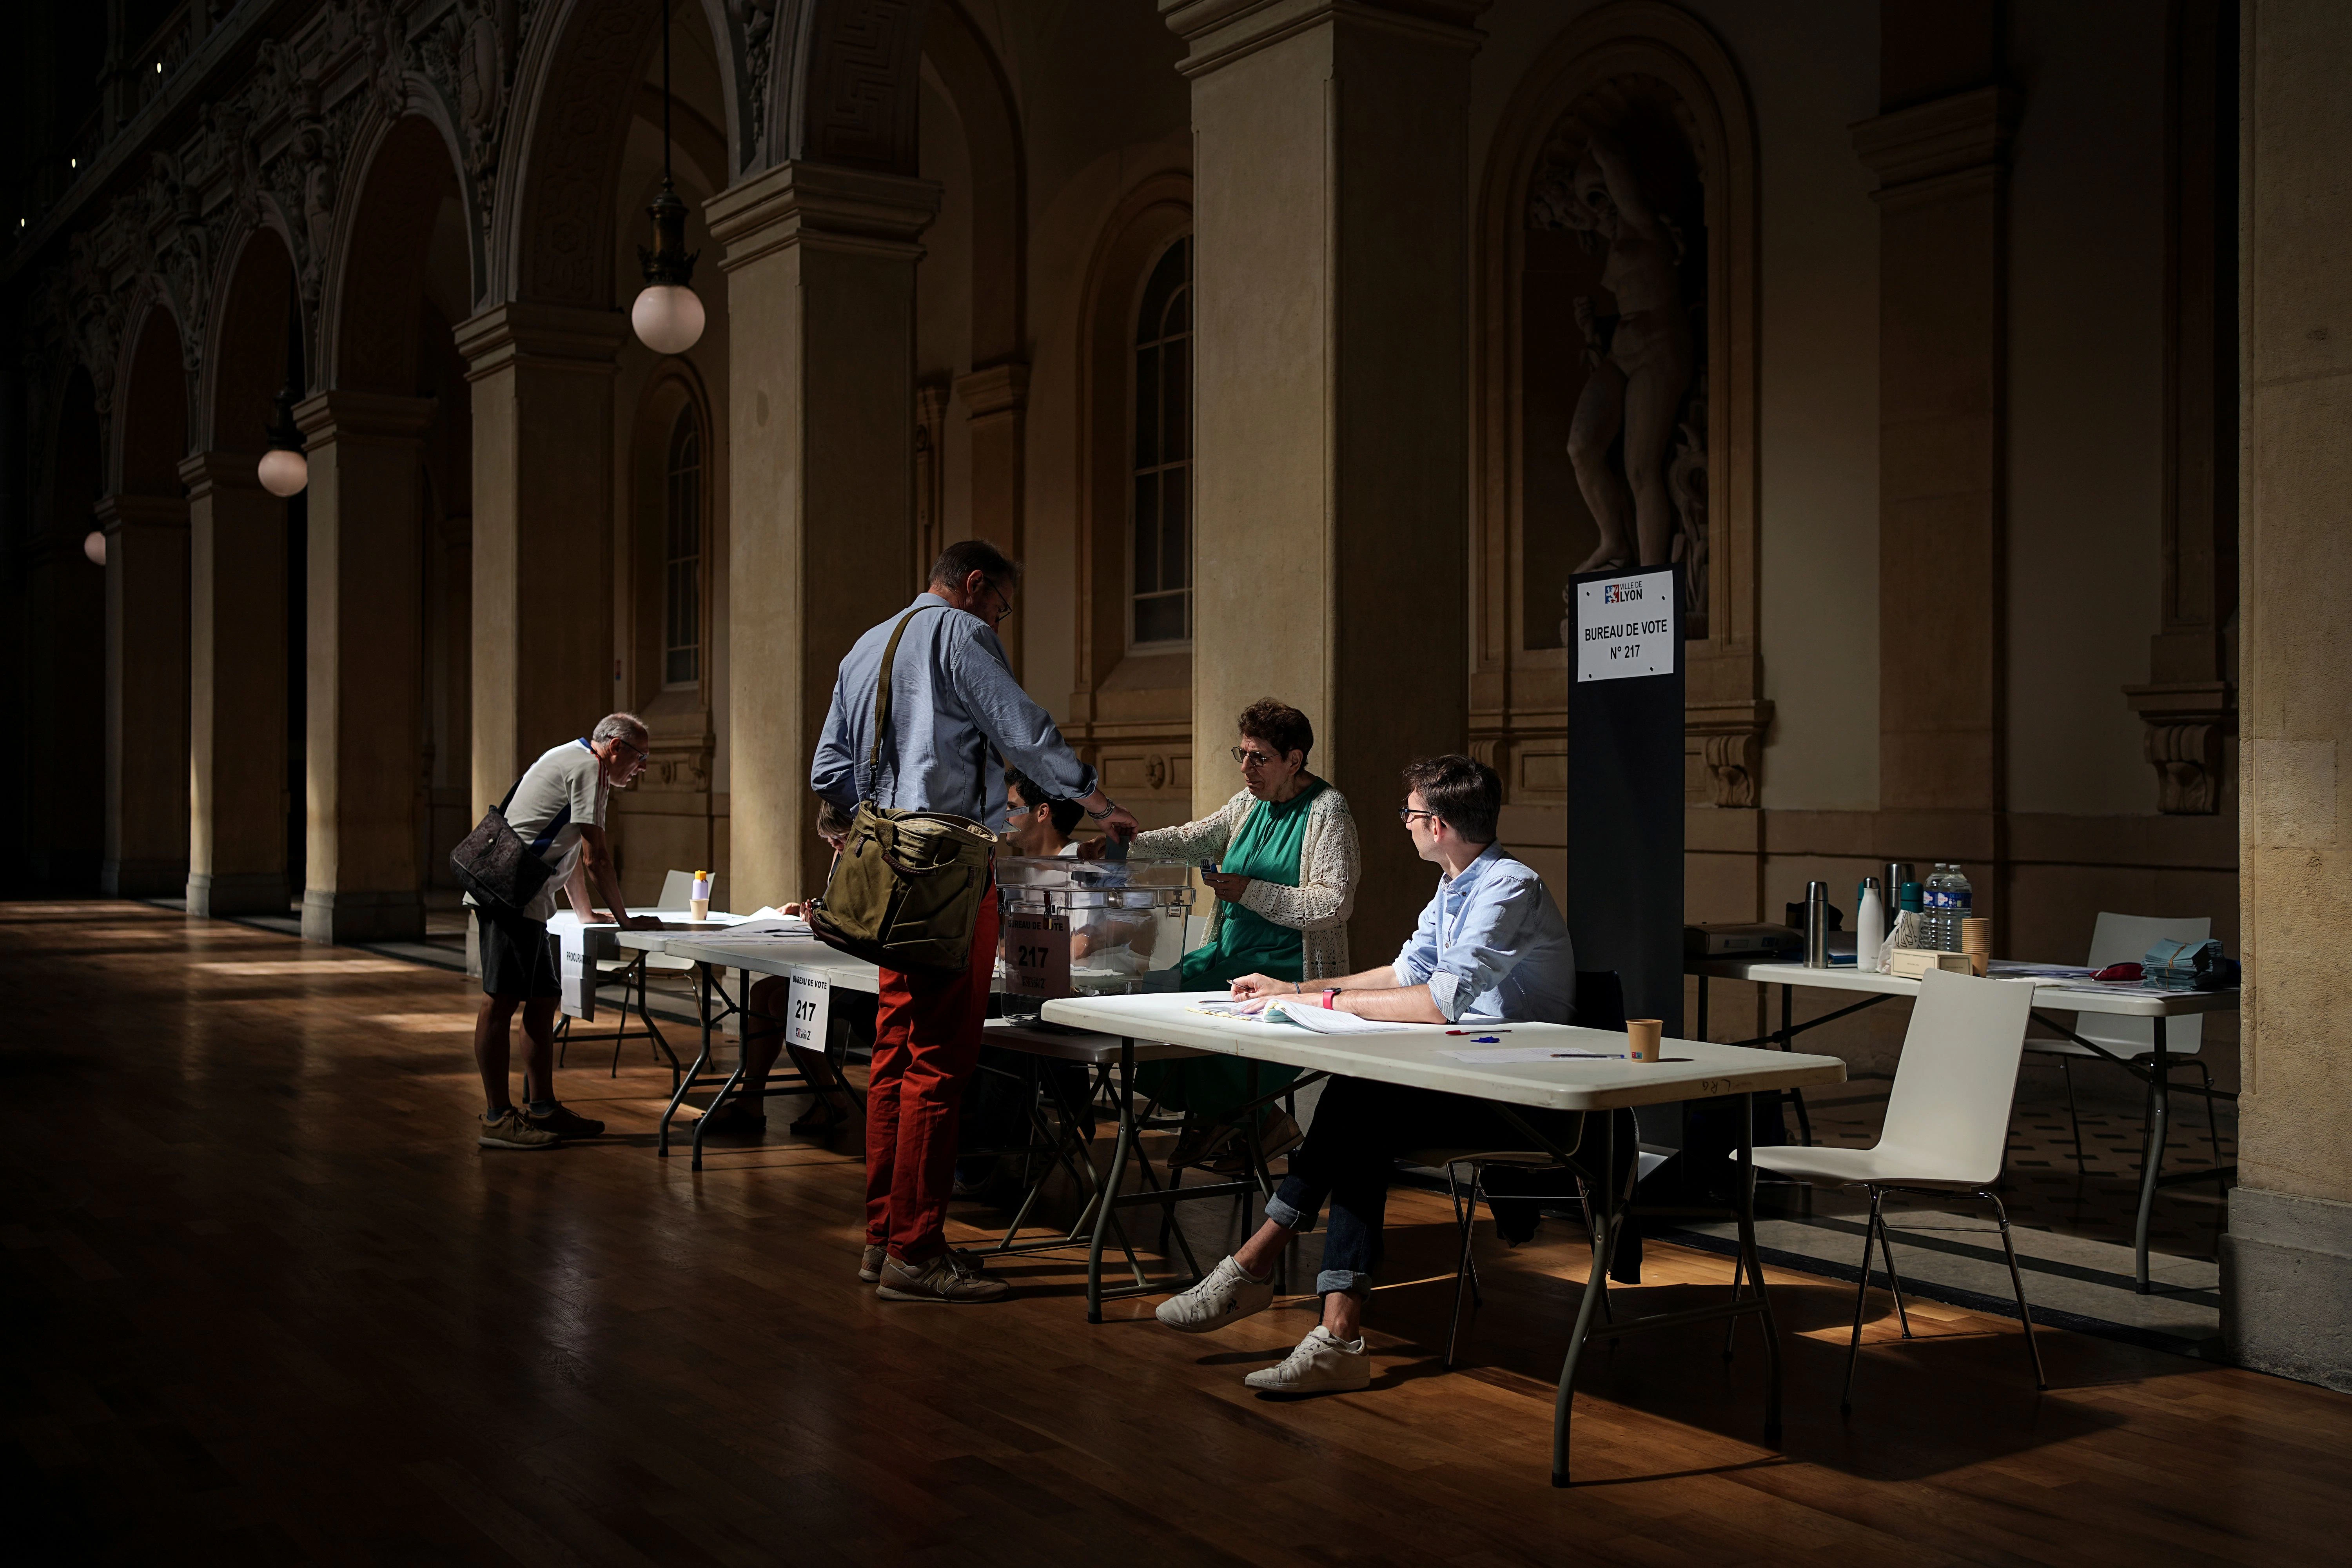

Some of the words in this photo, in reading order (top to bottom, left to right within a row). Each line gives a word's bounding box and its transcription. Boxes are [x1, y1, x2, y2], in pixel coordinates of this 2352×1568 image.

[1620, 588, 1642, 602] LYON
[1585, 624, 1623, 641] BUREAU
[1626, 623, 1639, 636] DE
[1641, 619, 1667, 634] VOTE
[1610, 646, 1622, 659] N°
[1624, 644, 1640, 658] 217
[1008, 919, 1030, 929] BUREAU
[1033, 922, 1041, 930] DE
[566, 951, 591, 966] PROCURATIONS
[1018, 945, 1049, 968] 217
[793, 975, 807, 985] BUREAU
[814, 980, 827, 989] VOTE
[795, 999, 816, 1022] 217
